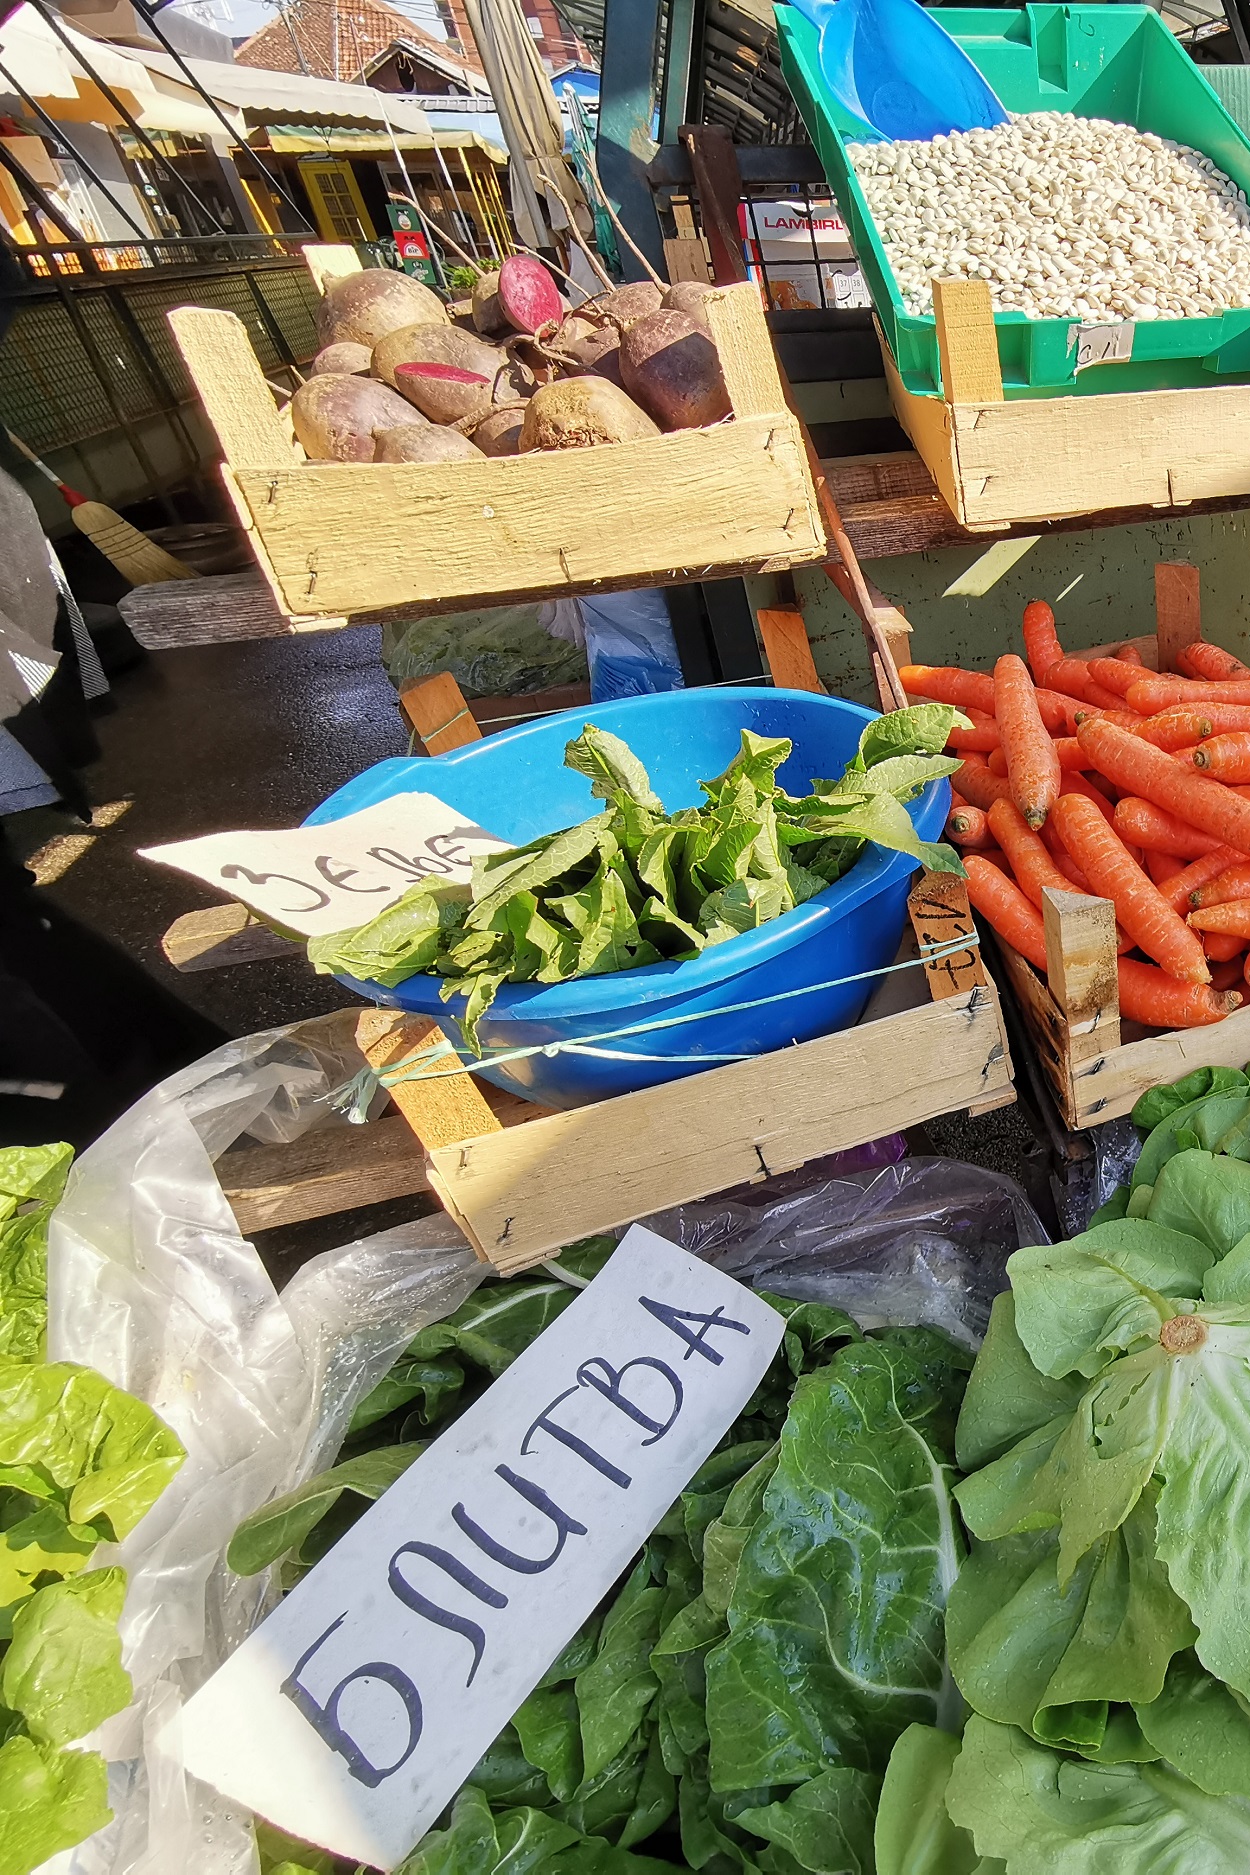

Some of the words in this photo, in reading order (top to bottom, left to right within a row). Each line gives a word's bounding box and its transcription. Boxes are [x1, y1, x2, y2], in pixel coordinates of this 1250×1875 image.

[840, 279, 847, 287] 37
[853, 279, 861, 287] 38
[279, 1295, 751, 1789] БЛИТВА
